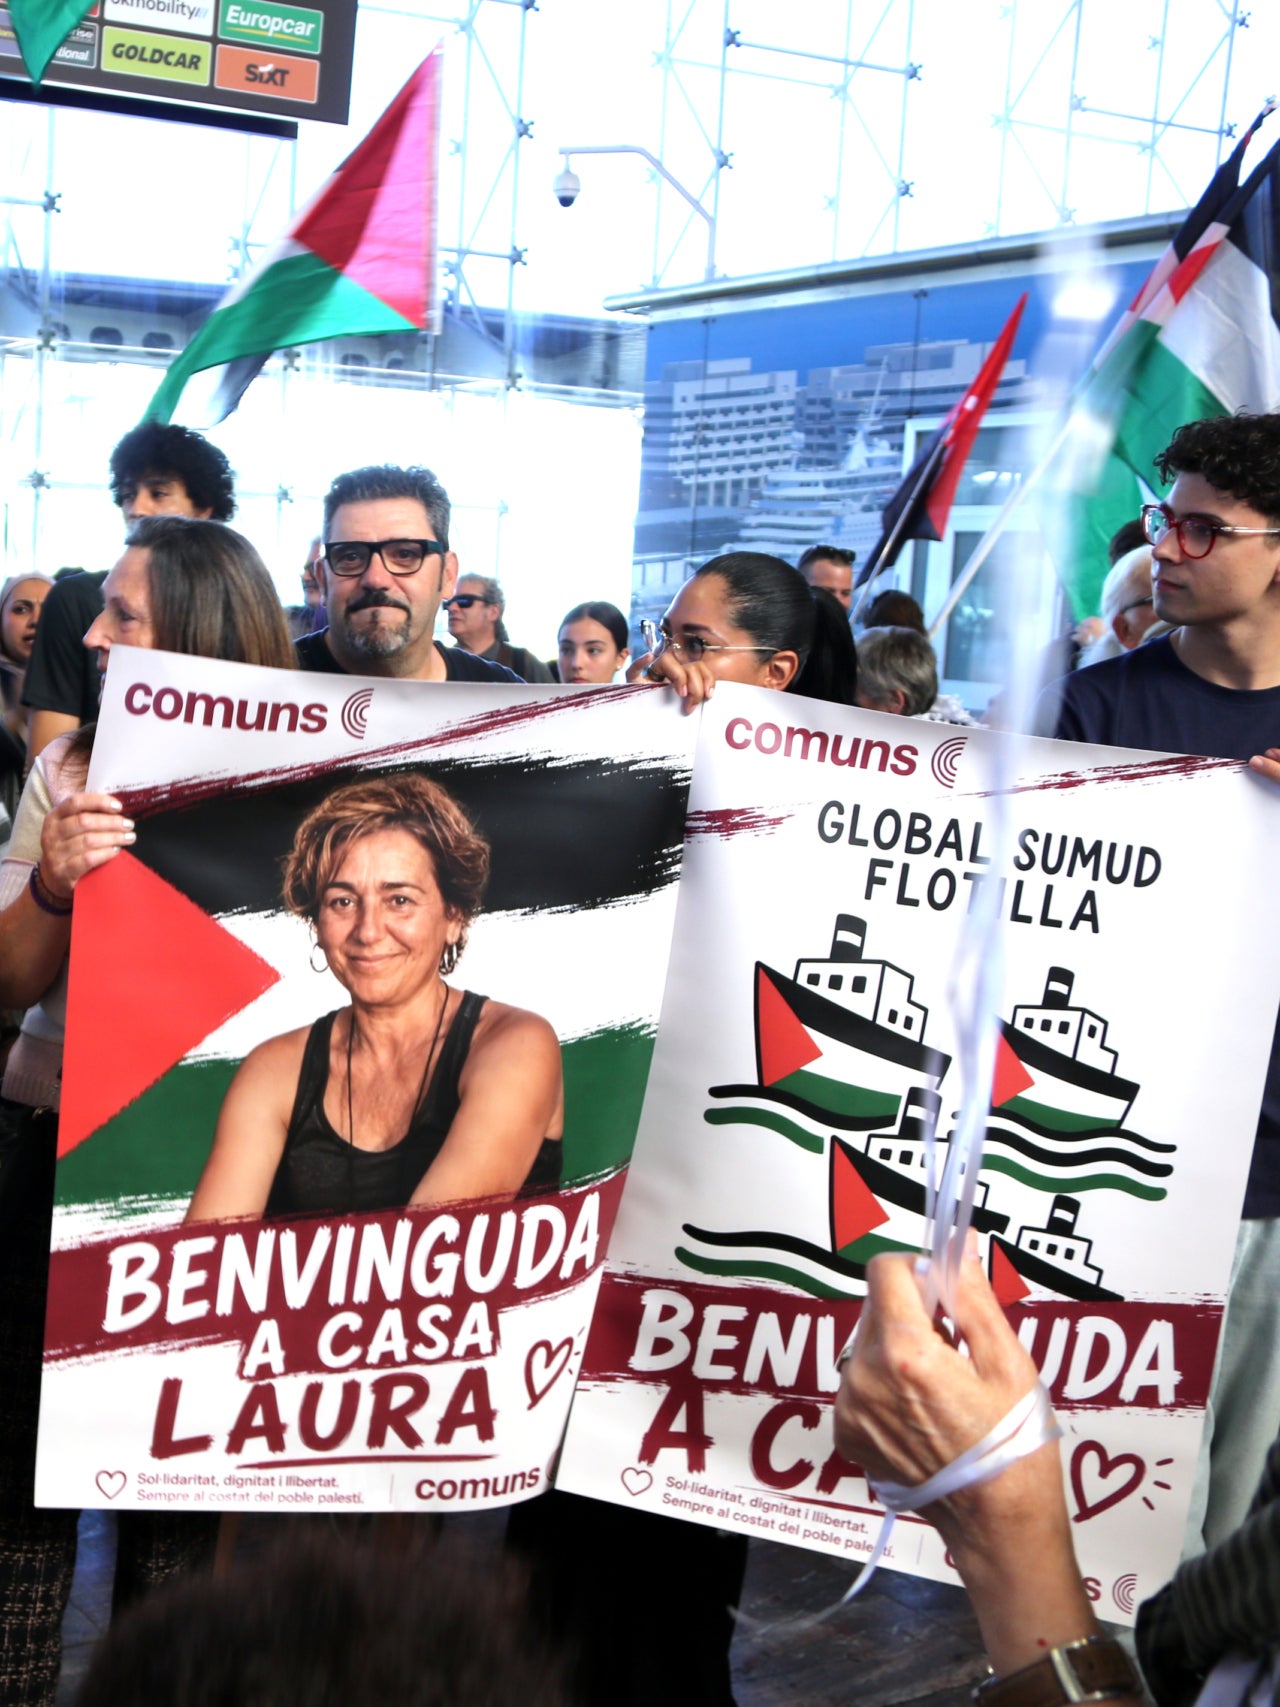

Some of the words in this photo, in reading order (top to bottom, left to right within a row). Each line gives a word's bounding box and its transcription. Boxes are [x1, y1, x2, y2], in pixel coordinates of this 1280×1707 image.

[225, 5, 316, 37] Europcar
[111, 43, 202, 70] GOLDCAR
[124, 682, 328, 734] comuns
[725, 717, 919, 776] comuns
[817, 800, 991, 865] GLOBAL
[1013, 828, 1162, 888] SUMUD
[101, 1192, 601, 1334] BENVINGUDA
[241, 1318, 285, 1377] A
[317, 1301, 495, 1368] CASA
[628, 1288, 1183, 1406] BENVUDA
[149, 1366, 498, 1459] LAURA
[637, 1381, 716, 1474] A
[137, 1488, 190, 1503] Sempre
[193, 1490, 205, 1502] al
[208, 1491, 249, 1502] costat
[254, 1491, 274, 1503] del
[278, 1491, 314, 1504] poble
[223, 1474, 275, 1489] dignitat
[278, 1475, 283, 1487] i
[285, 1475, 340, 1488] llibertat.
[415, 1467, 541, 1501] comuns
[662, 1492, 714, 1515] Sempre
[717, 1507, 730, 1519] al
[732, 1512, 775, 1530] costat
[778, 1521, 800, 1535] del
[802, 1528, 842, 1545] poble
[844, 1538, 895, 1558] paletí.
[749, 1497, 801, 1518] dignitat
[804, 1508, 810, 1519] i
[811, 1509, 869, 1534] llibertat.
